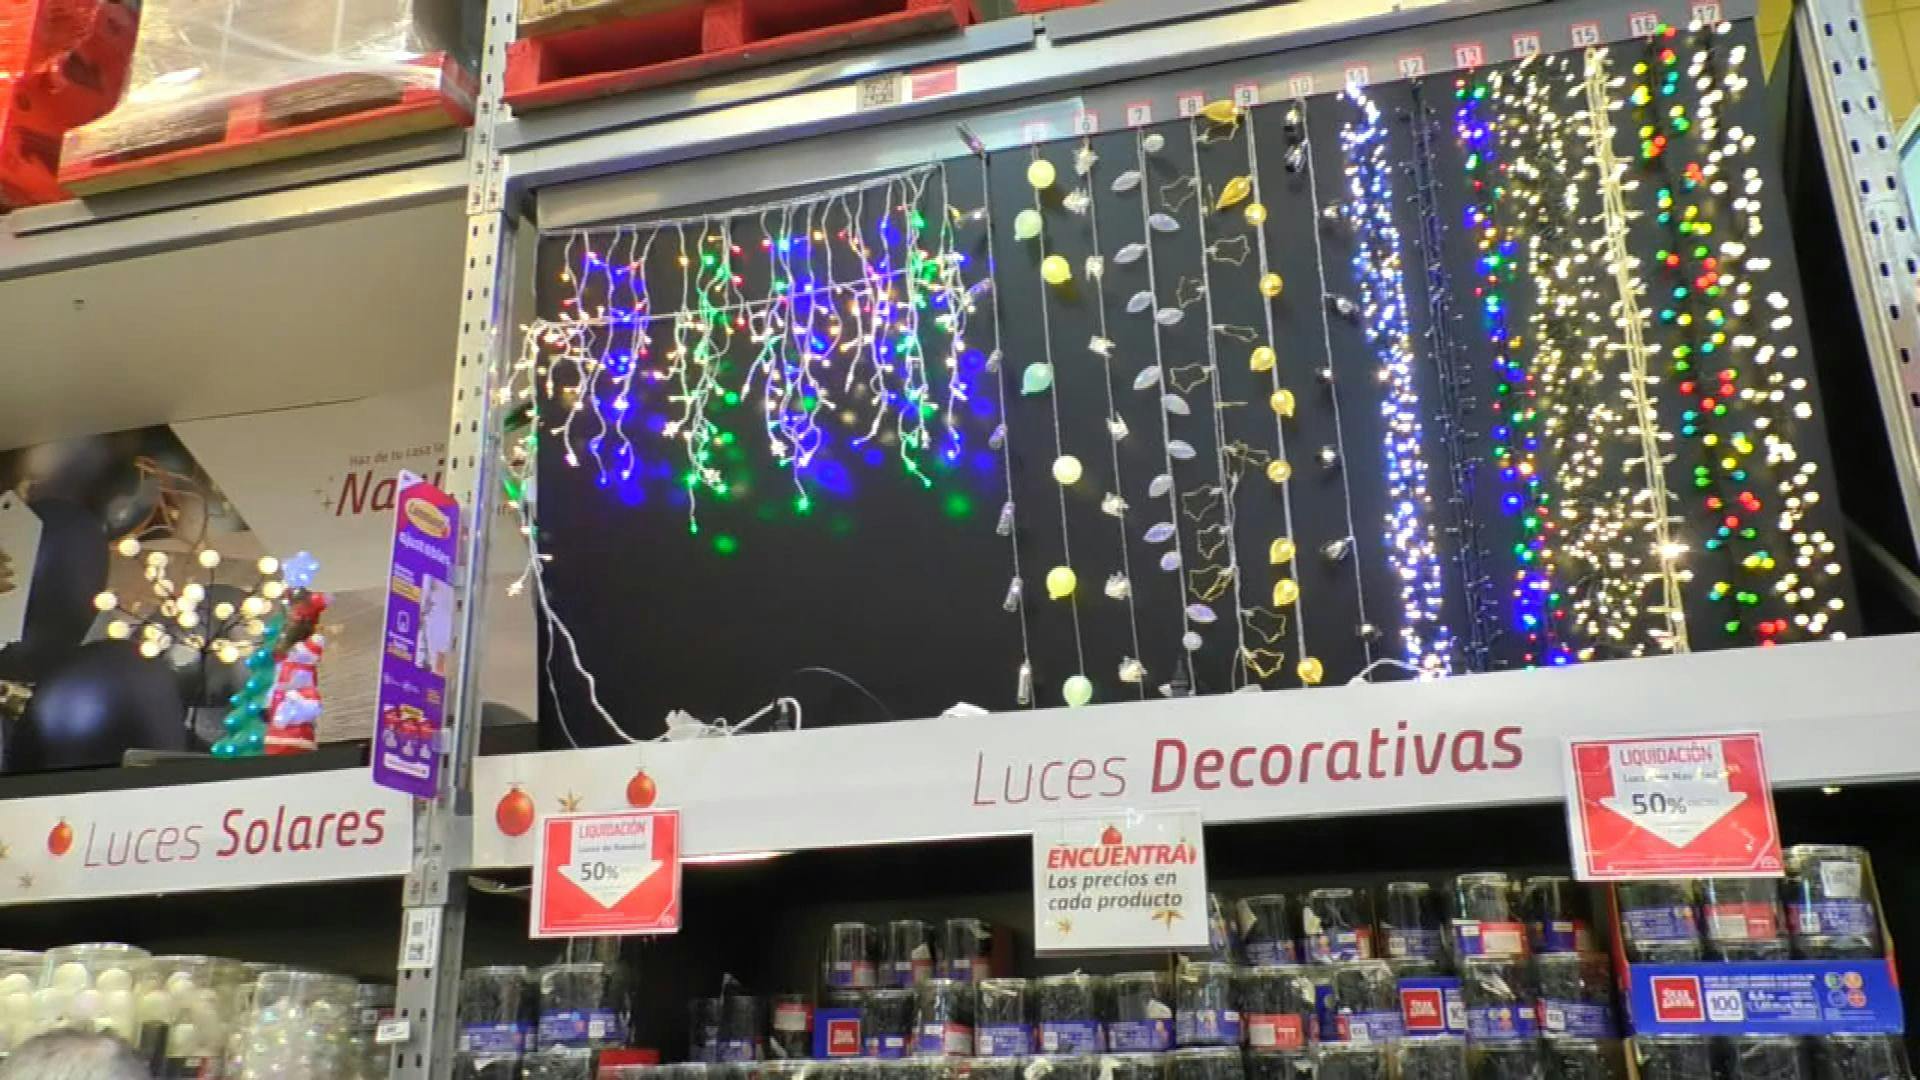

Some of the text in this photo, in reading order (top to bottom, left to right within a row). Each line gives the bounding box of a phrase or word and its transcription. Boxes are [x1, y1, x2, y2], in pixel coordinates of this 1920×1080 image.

[972, 720, 1523, 806] Luces Decorativas
[1620, 742, 1713, 766] LIQUIDACIÓN
[1632, 792, 1687, 815] 50%
[84, 804, 387, 868] Luces Solares
[1047, 843, 1188, 869] ENCUENTRA
[580, 862, 619, 881] 50%
[1082, 870, 1149, 891] precios
[1153, 872, 1177, 887] en
[1048, 891, 1183, 912] cada producto
[1711, 995, 1740, 1011] 100
